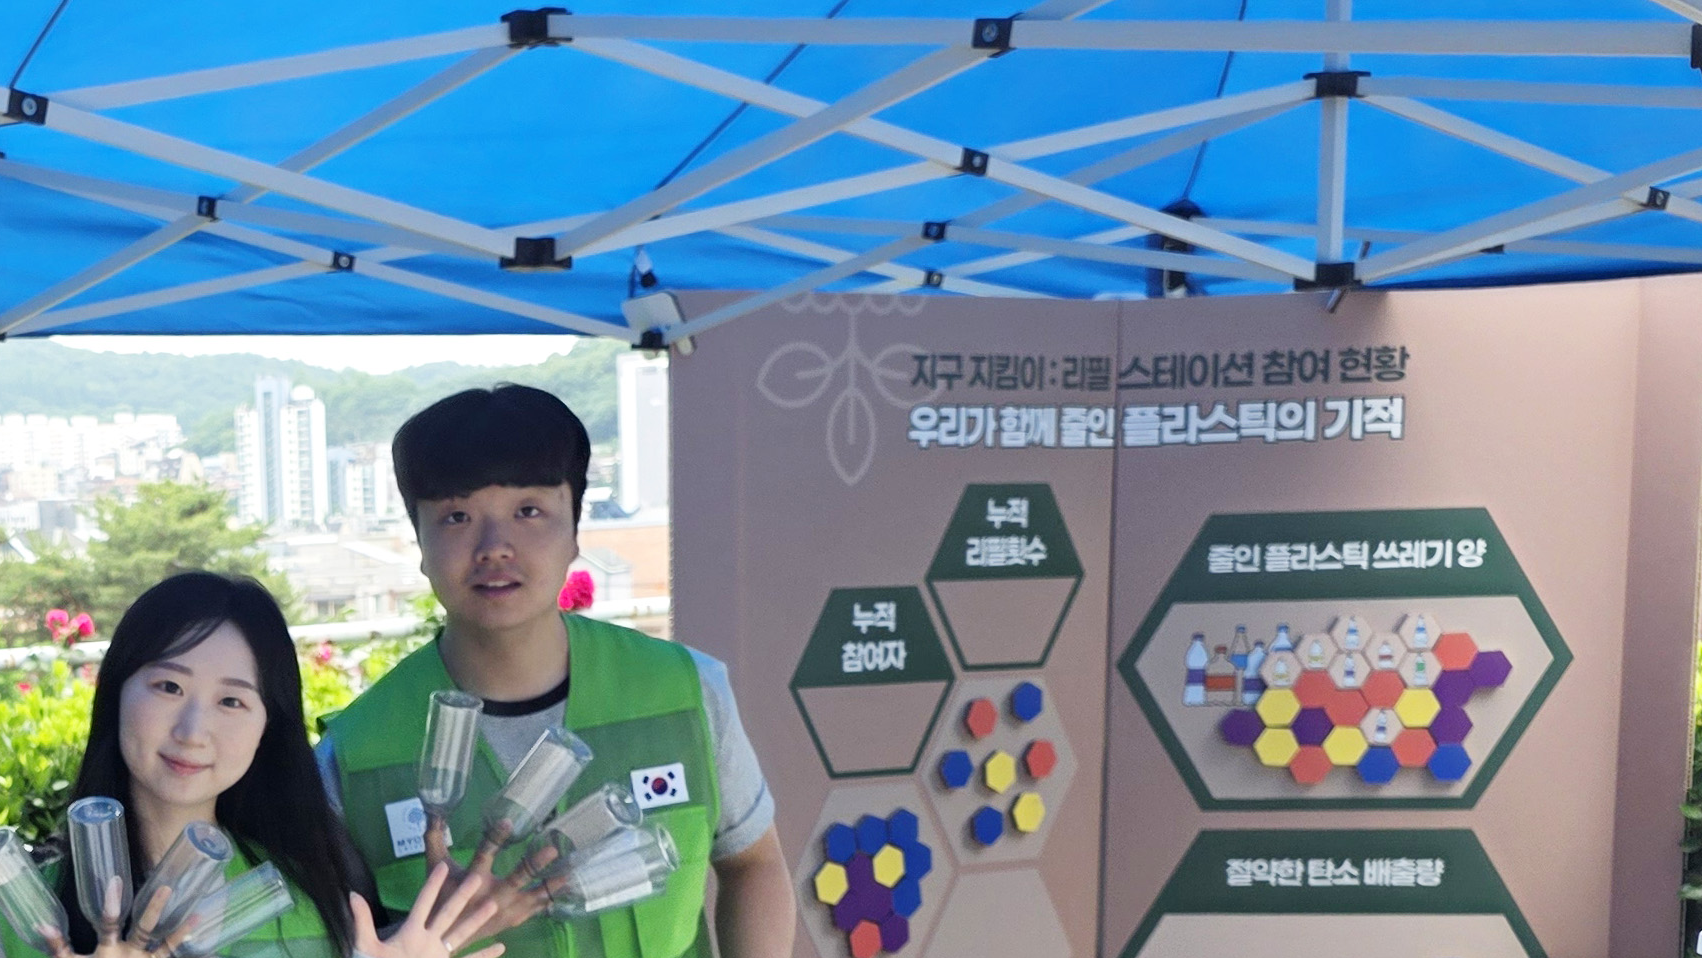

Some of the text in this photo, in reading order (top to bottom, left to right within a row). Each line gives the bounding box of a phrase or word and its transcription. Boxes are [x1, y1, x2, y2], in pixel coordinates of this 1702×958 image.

[910, 354, 964, 391] 지구
[1062, 356, 1112, 392] 리필
[1117, 351, 1255, 391] 스테이션
[1261, 348, 1331, 387] 참여
[1337, 344, 1411, 384] 현황
[907, 395, 1406, 449] 우리가 함께 줄인 플라스틱의 기적
[985, 497, 1030, 530] 누적
[1207, 537, 1488, 574] 줄인 플라스틱 쓰레기 양
[851, 600, 897, 635] 누적
[841, 639, 908, 674] 참여자
[1225, 857, 1446, 887] 절약한 탄소 배출량
